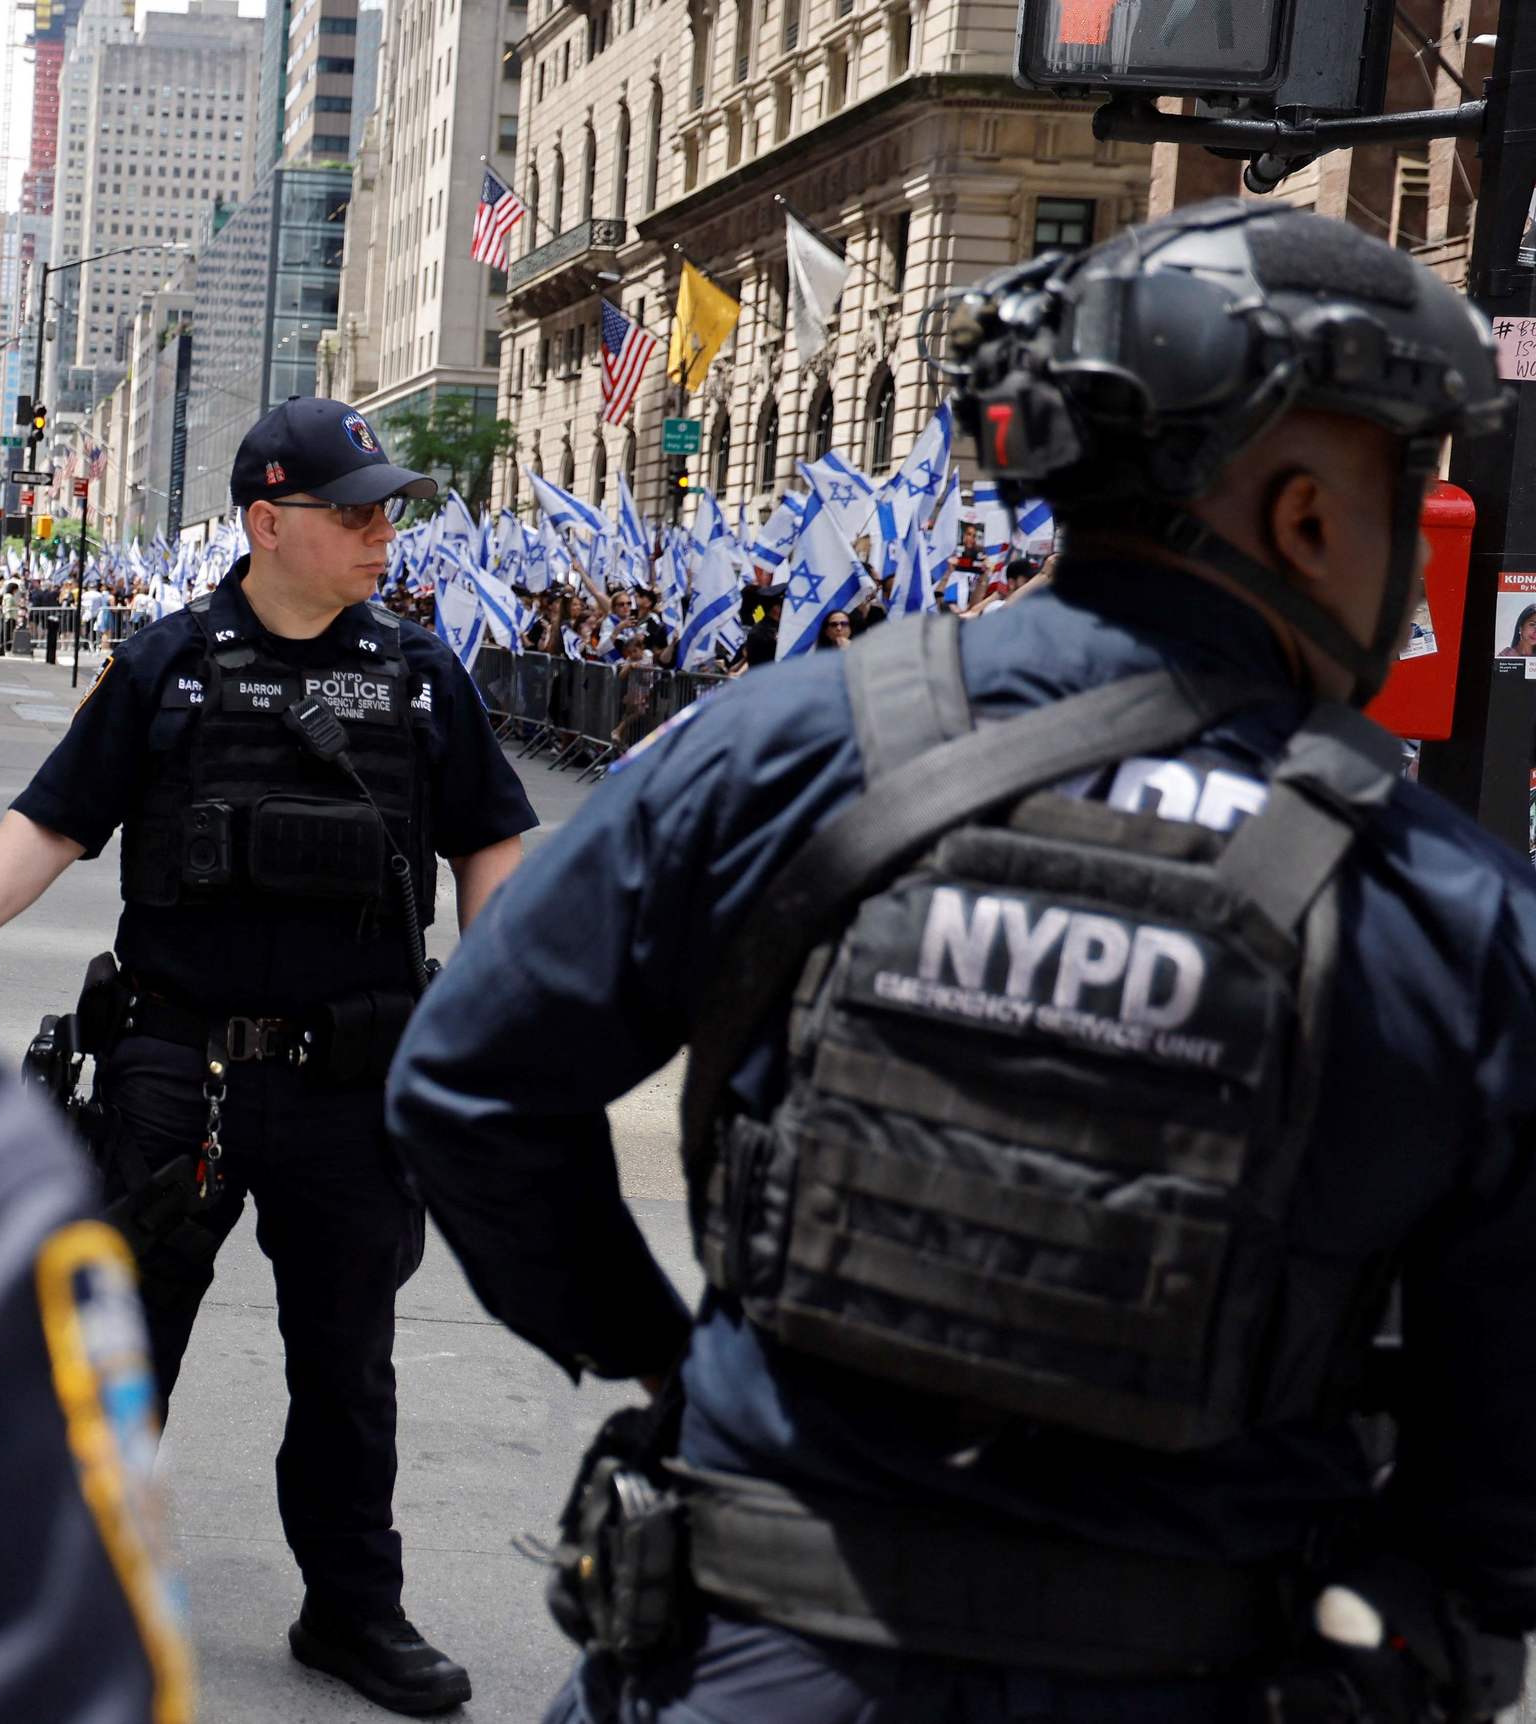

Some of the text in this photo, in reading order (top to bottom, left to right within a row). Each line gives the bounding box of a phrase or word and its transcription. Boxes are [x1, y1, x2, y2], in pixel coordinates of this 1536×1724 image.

[1515, 340, 1536, 358] IS
[987, 404, 1013, 467] 7
[216, 629, 235, 642] K9
[358, 638, 377, 652] K9
[332, 671, 363, 683] NYPD
[239, 682, 282, 696] BARRON
[305, 679, 391, 701] POLICE
[189, 692, 204, 704] 64
[252, 696, 270, 708] 646
[324, 696, 391, 712] GENCY SERVICE
[334, 707, 365, 719] CANINE
[917, 887, 1205, 1030] NYPD
[874, 970, 1224, 1069] EMERGENCY SERVICE UNIT
